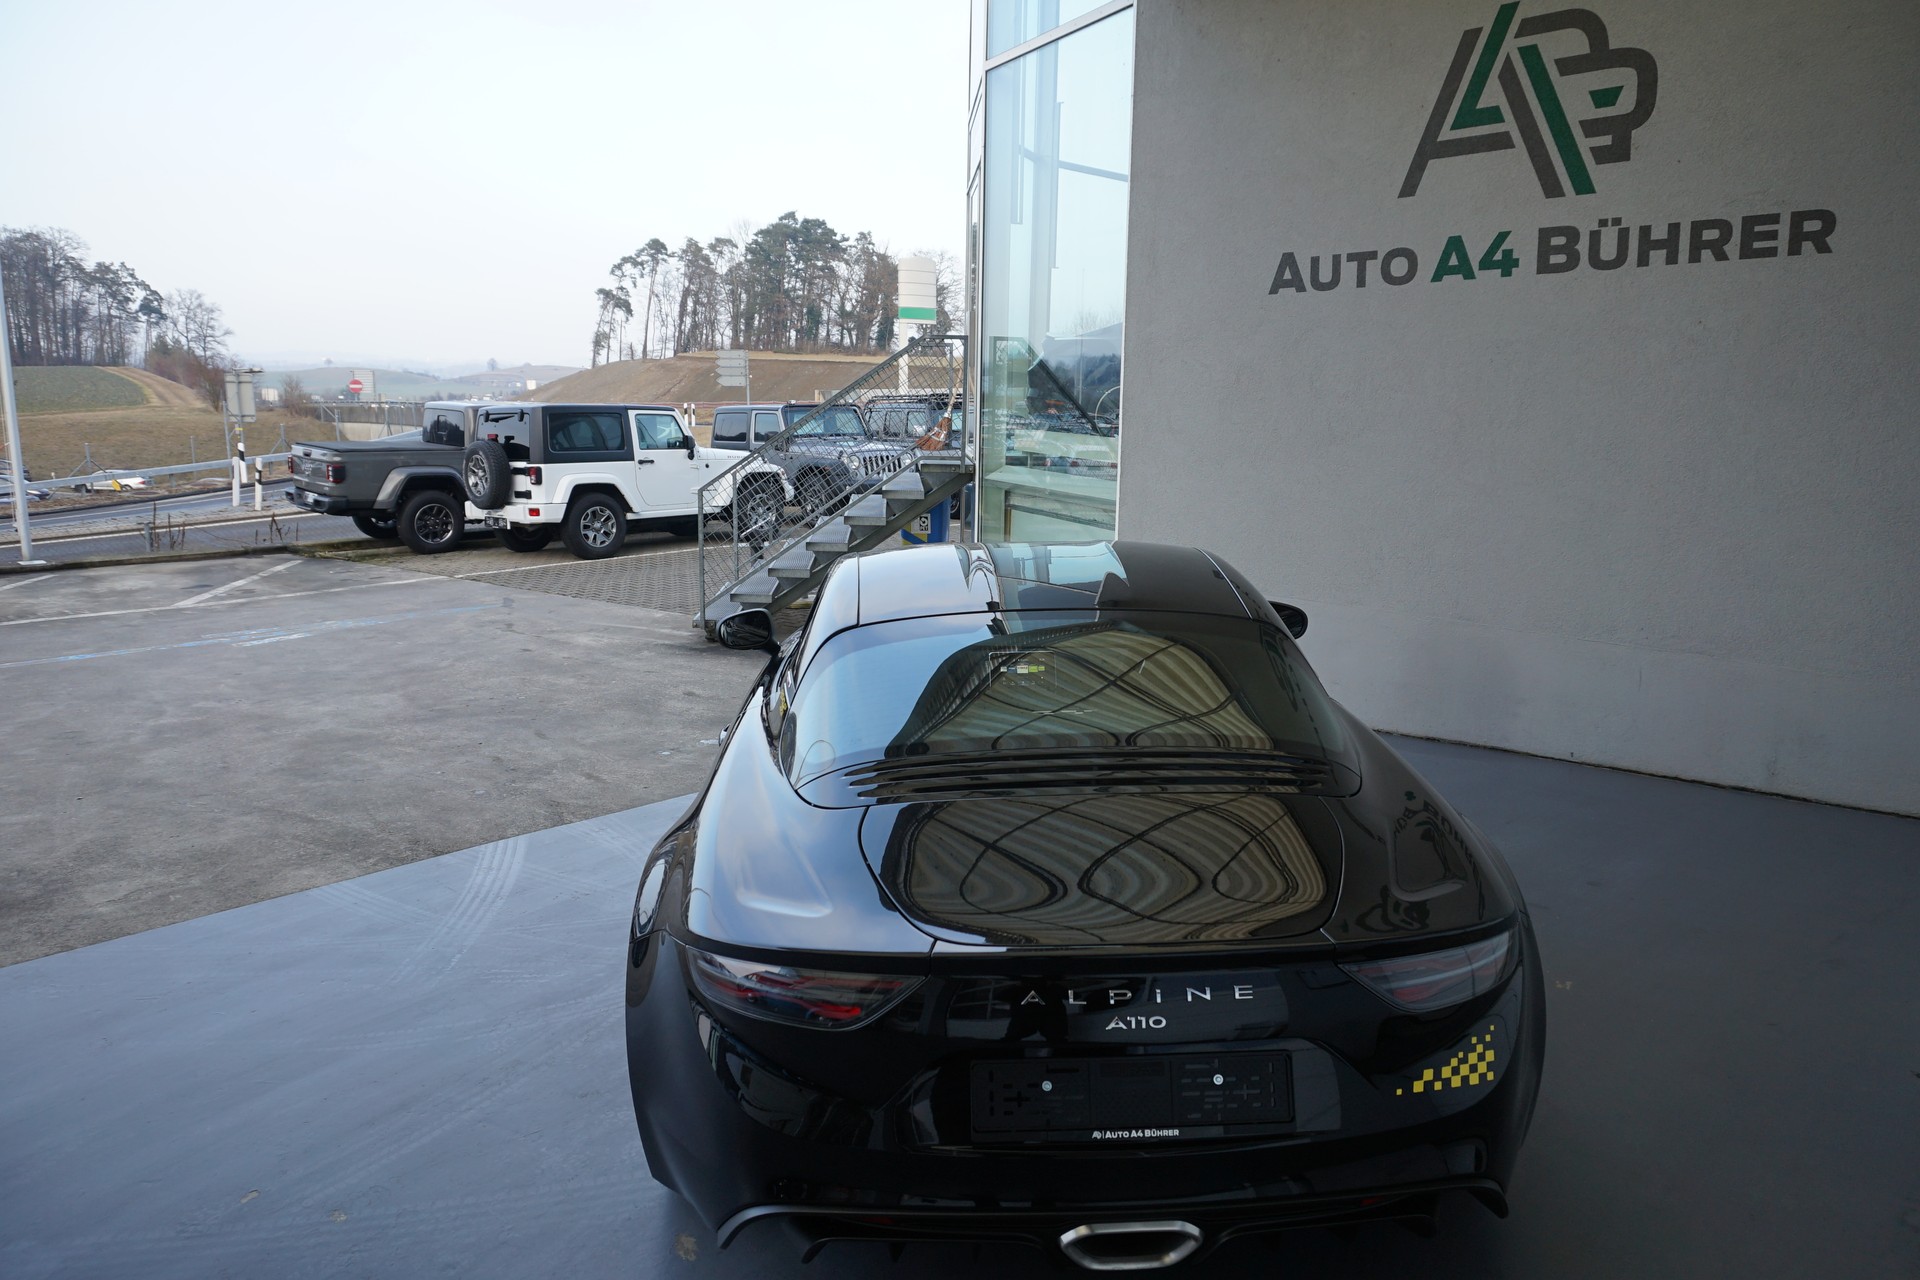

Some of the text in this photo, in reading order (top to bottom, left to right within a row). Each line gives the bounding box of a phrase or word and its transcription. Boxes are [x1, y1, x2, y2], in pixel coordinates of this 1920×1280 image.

[1268, 209, 1837, 295] AUTO A4 BÜHRER
[1105, 1016, 1167, 1031] A110
[1105, 1130, 1129, 1139] AUTO
[1130, 1129, 1143, 1138] A4
[1144, 1128, 1180, 1137] BÜHRER
